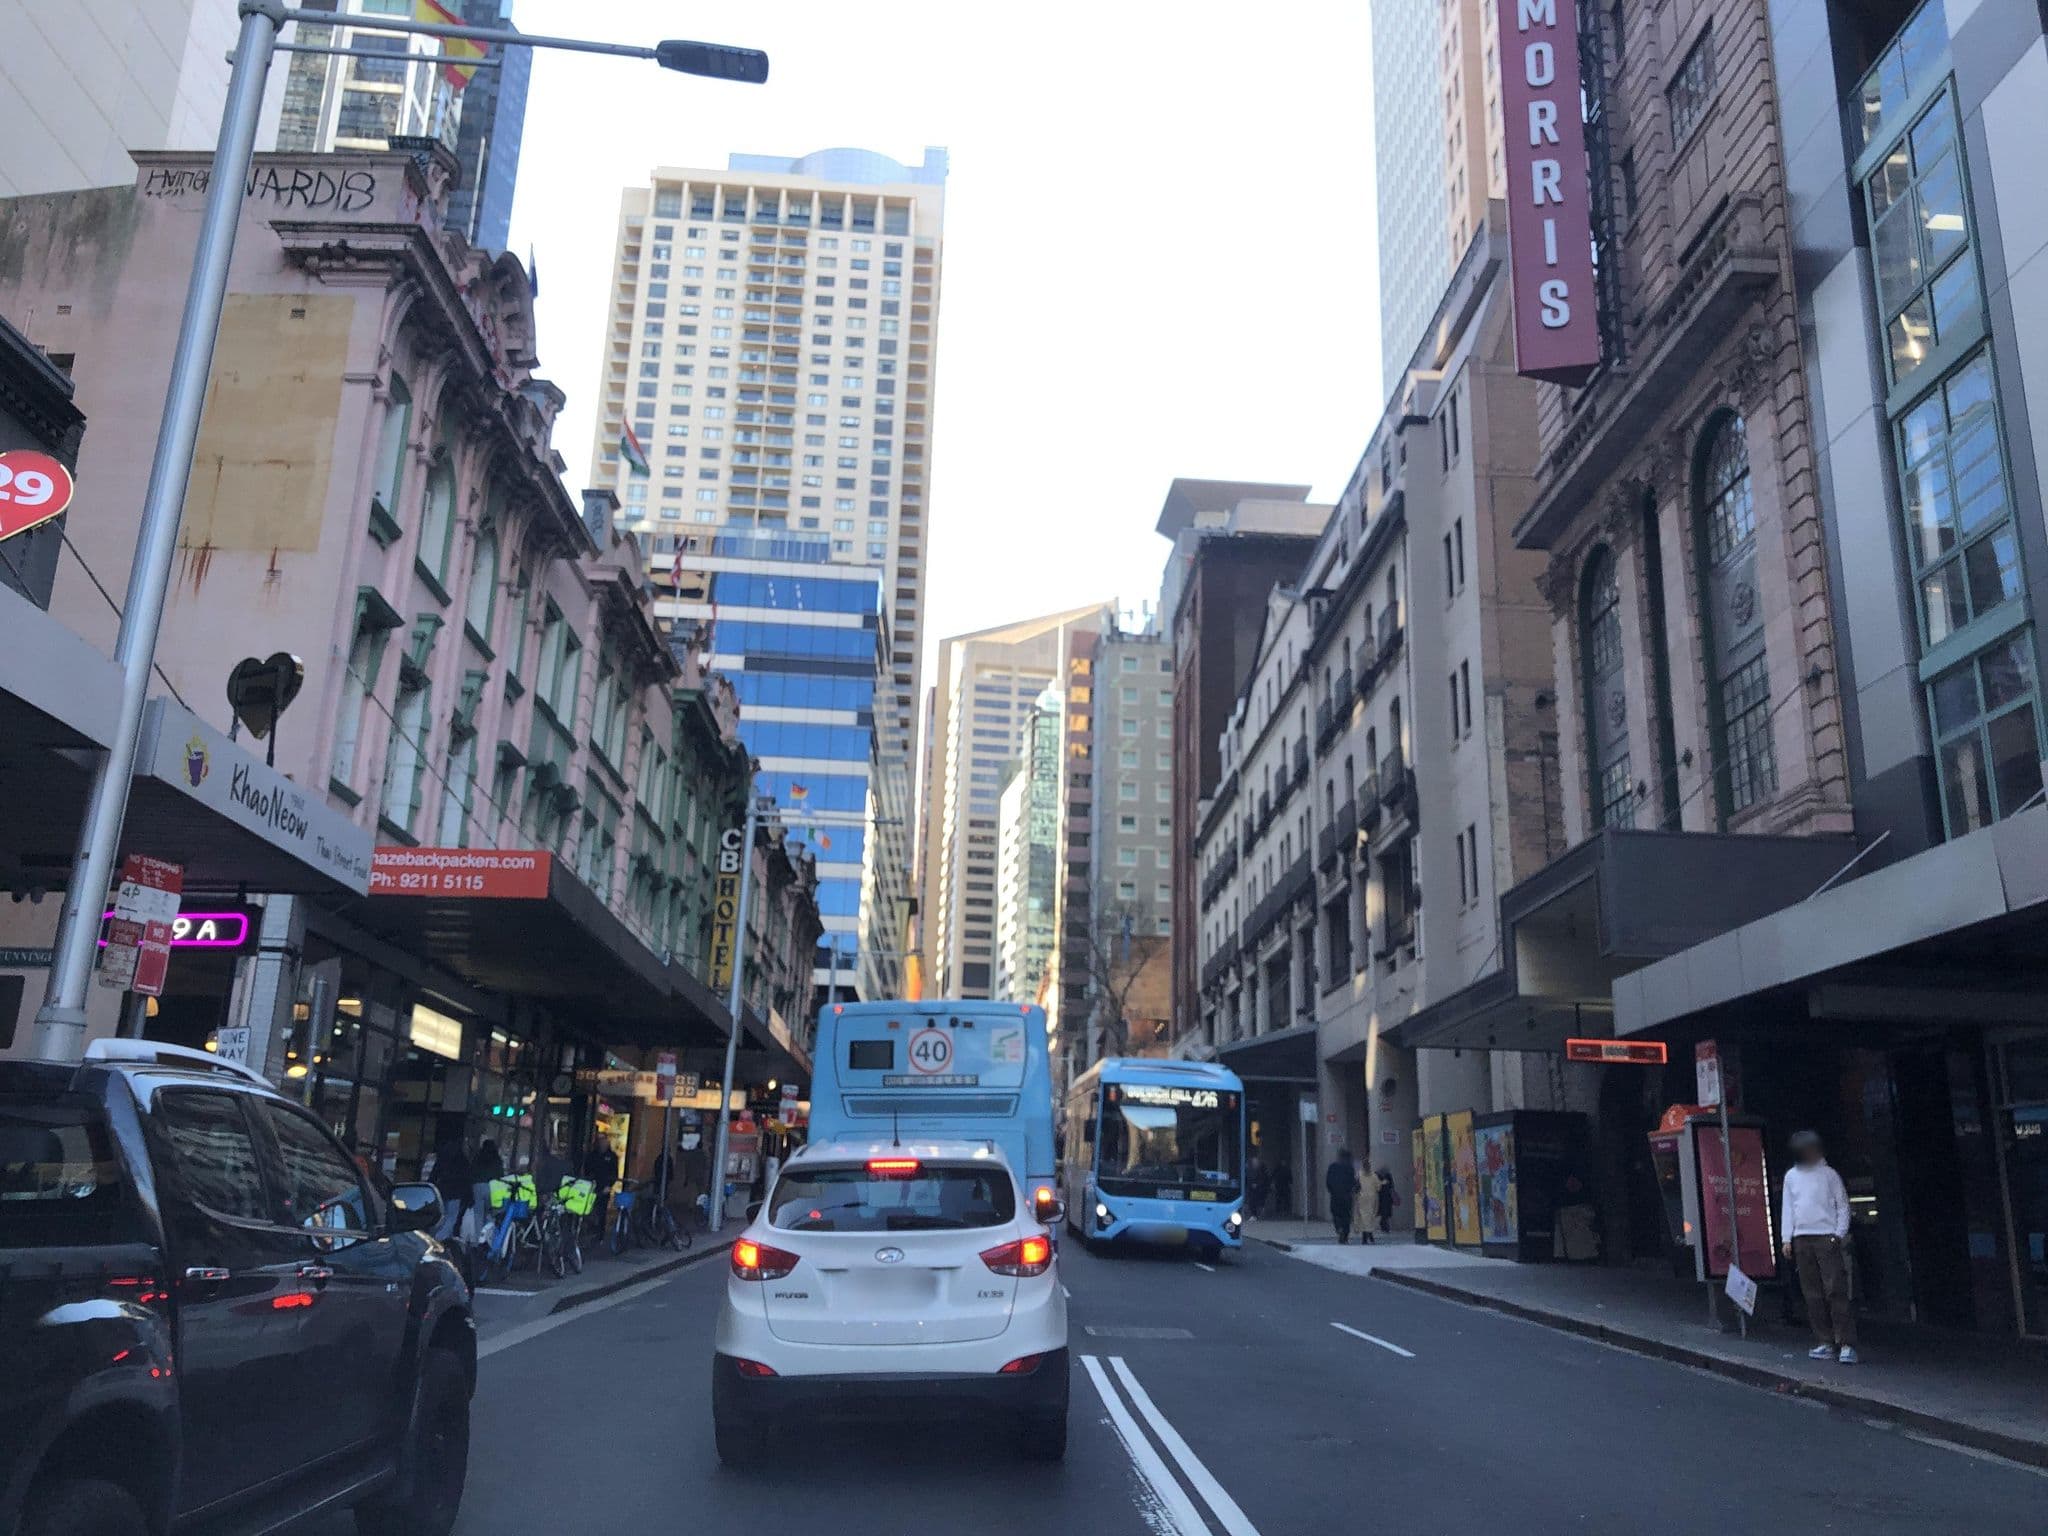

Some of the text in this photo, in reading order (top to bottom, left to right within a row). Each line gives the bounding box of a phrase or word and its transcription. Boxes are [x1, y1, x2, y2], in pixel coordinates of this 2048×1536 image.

[1518, 0, 1570, 328] MORRIS
[370, 871, 484, 890] Ph: 9211 5115
[713, 878, 736, 988] HOTEL
[219, 1047, 246, 1060] WAY
[915, 1040, 947, 1062] 40
[1191, 1090, 1218, 1108] 426
